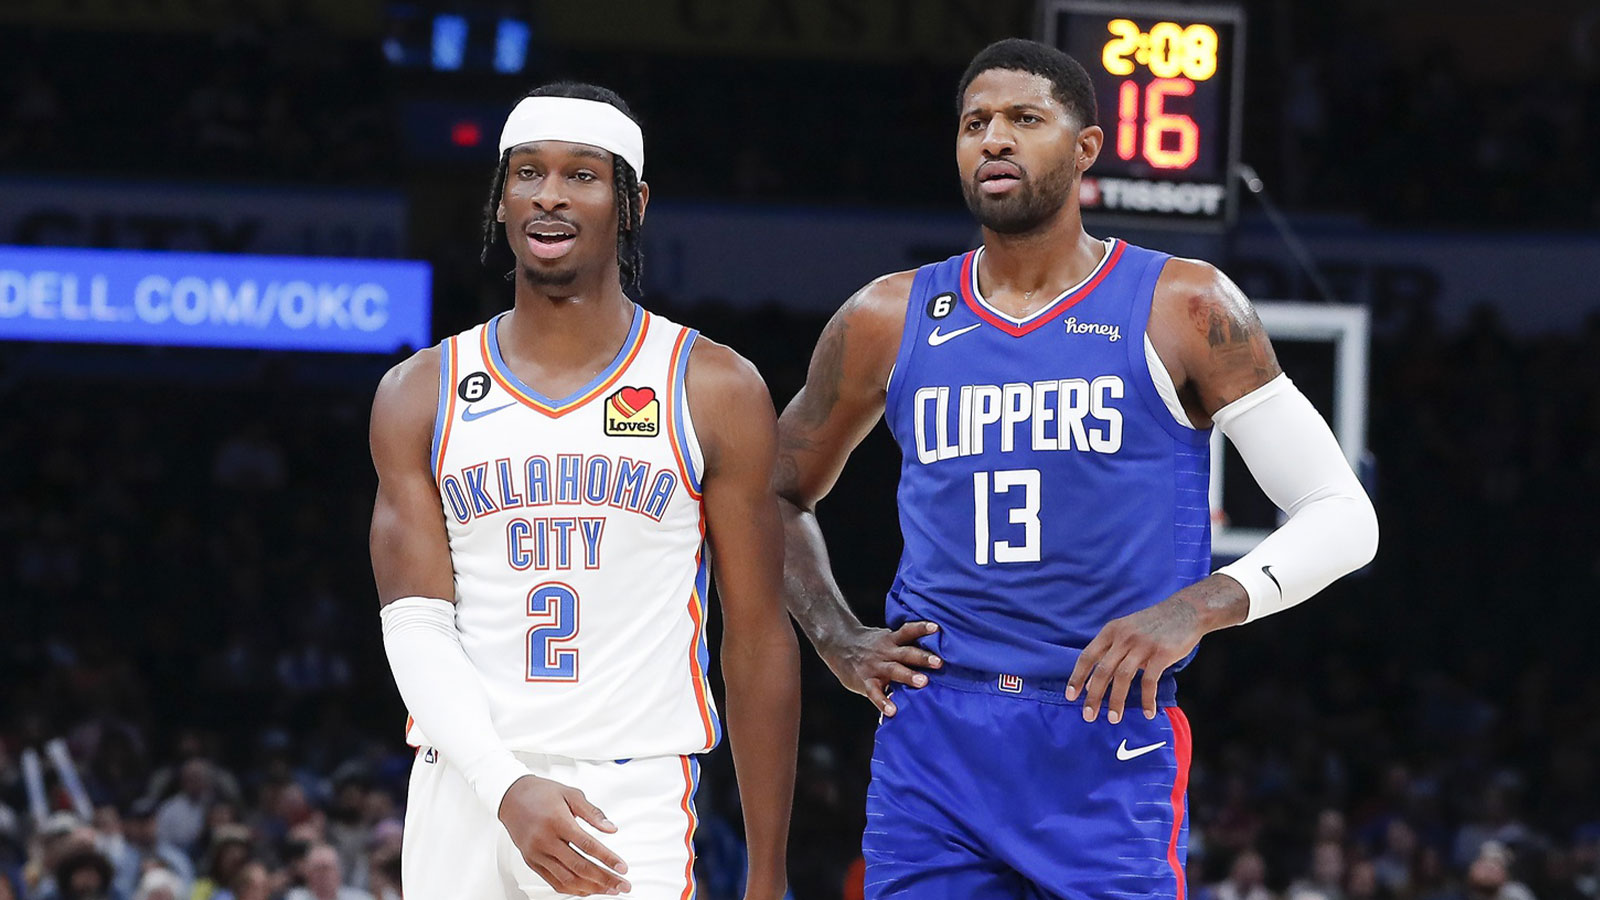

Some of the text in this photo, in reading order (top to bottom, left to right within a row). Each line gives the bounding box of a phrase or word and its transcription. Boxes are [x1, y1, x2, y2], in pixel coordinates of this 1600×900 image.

[1102, 19, 1219, 81] 2:08
[1117, 77, 1199, 170] 16
[1099, 177, 1224, 215] TISSOT
[932, 295, 952, 318] 6
[1064, 317, 1121, 342] honey
[464, 375, 485, 399] 6
[914, 375, 1125, 465] CLIPPERS
[442, 453, 678, 525] OKLAHOMA
[973, 468, 1041, 565] 13
[506, 516, 606, 571] CITY
[525, 581, 580, 682] 2
